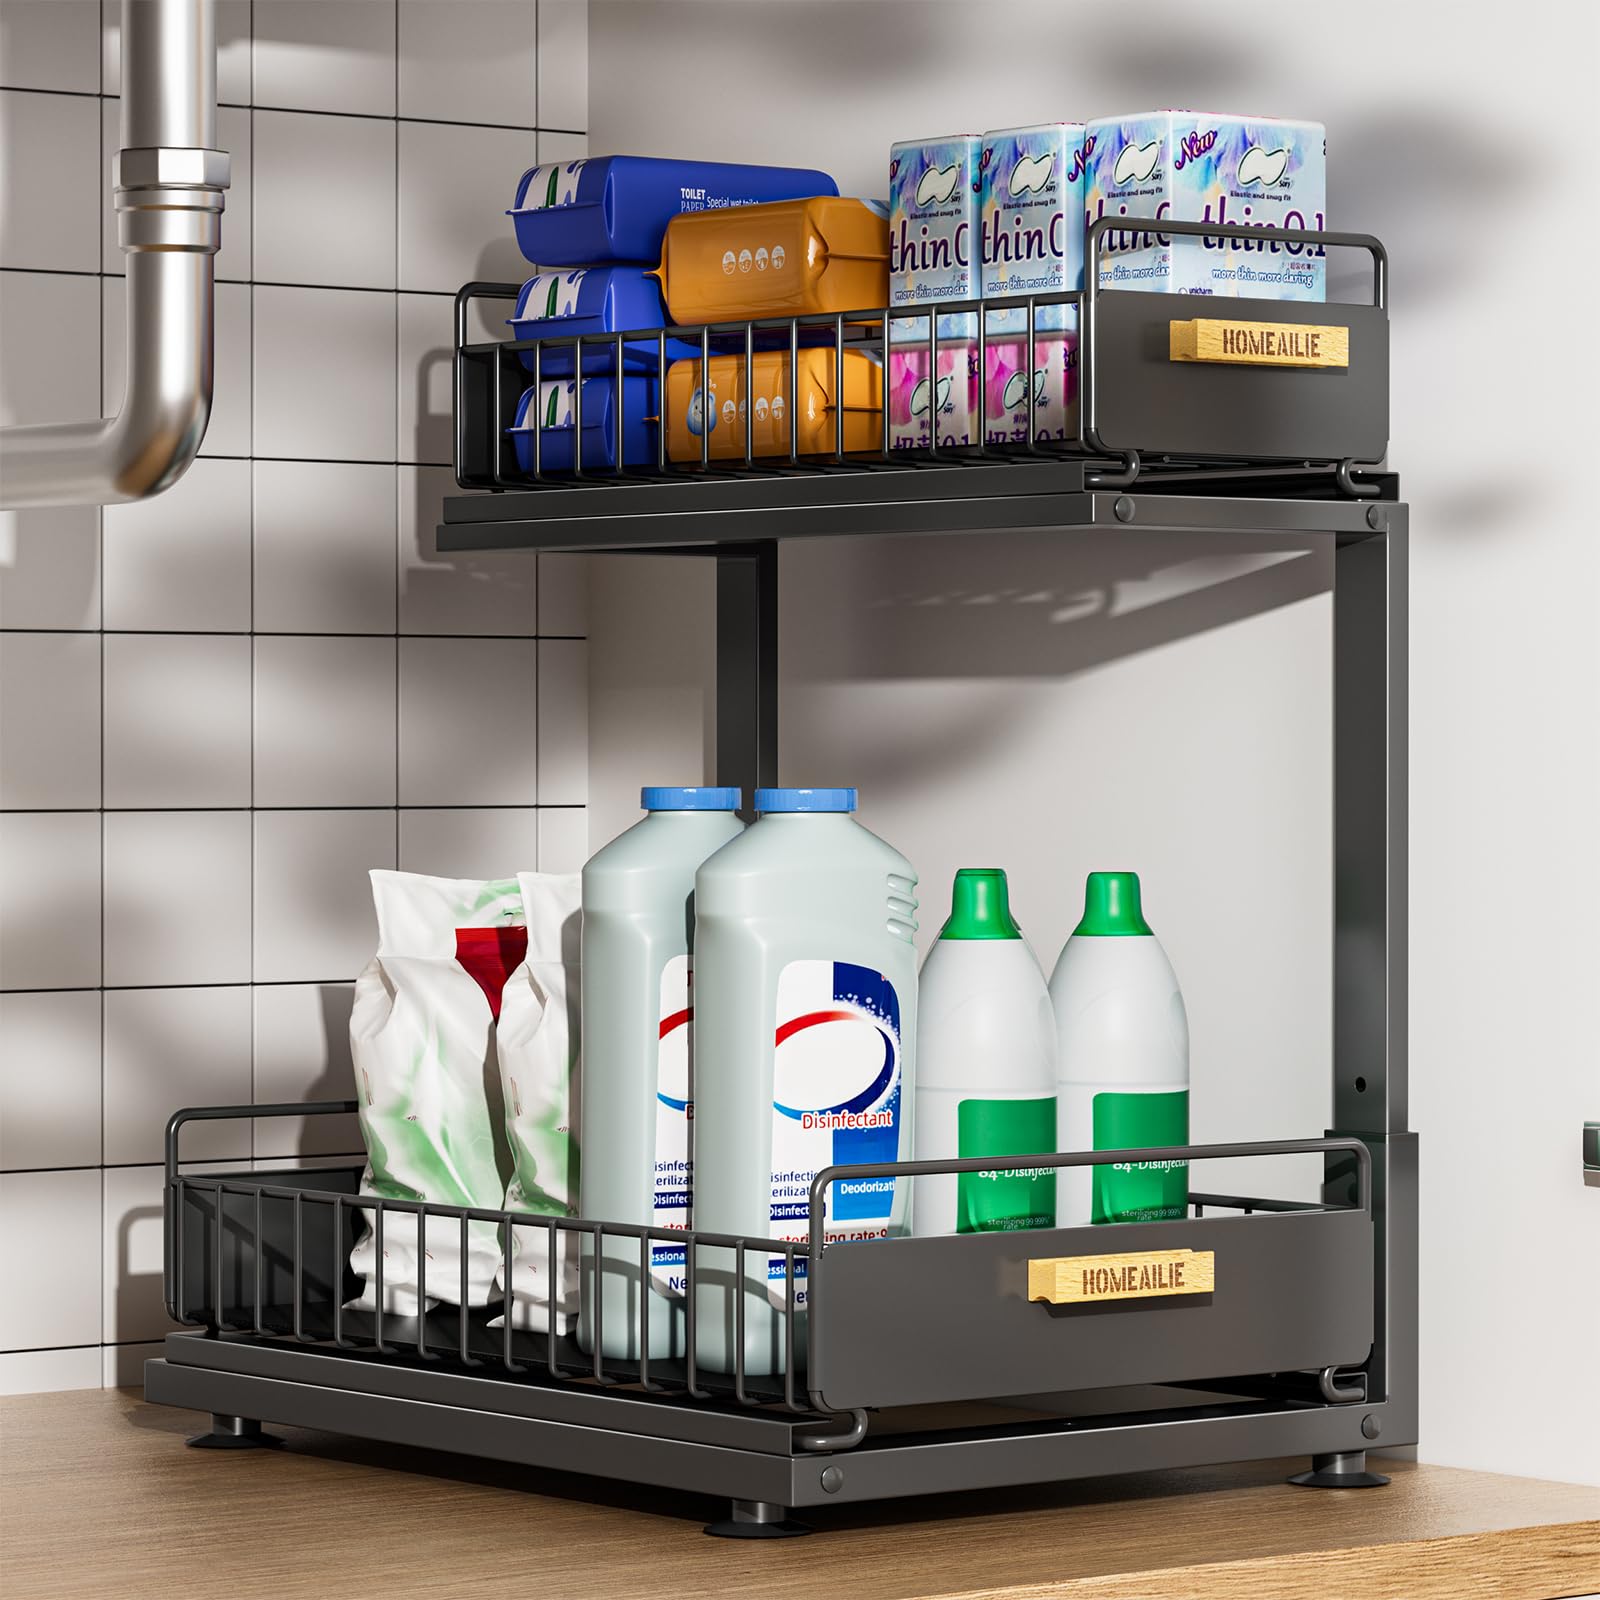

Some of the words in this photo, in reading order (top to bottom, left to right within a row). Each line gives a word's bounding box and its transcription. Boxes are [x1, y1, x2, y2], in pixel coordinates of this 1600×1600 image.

[1175, 130, 1218, 170] New
[681, 188, 706, 200] TOILET
[707, 196, 730, 209] Special
[1009, 274, 1026, 289] thin
[1099, 271, 1113, 281] ore
[1113, 265, 1131, 280] thin
[1236, 264, 1257, 281] thin
[1283, 268, 1314, 288] daring
[916, 283, 932, 297] thin
[1223, 328, 1322, 358] HOMEAILIE
[802, 1110, 892, 1129] Disinfectant
[1082, 1262, 1185, 1295] HOMEAILIE
